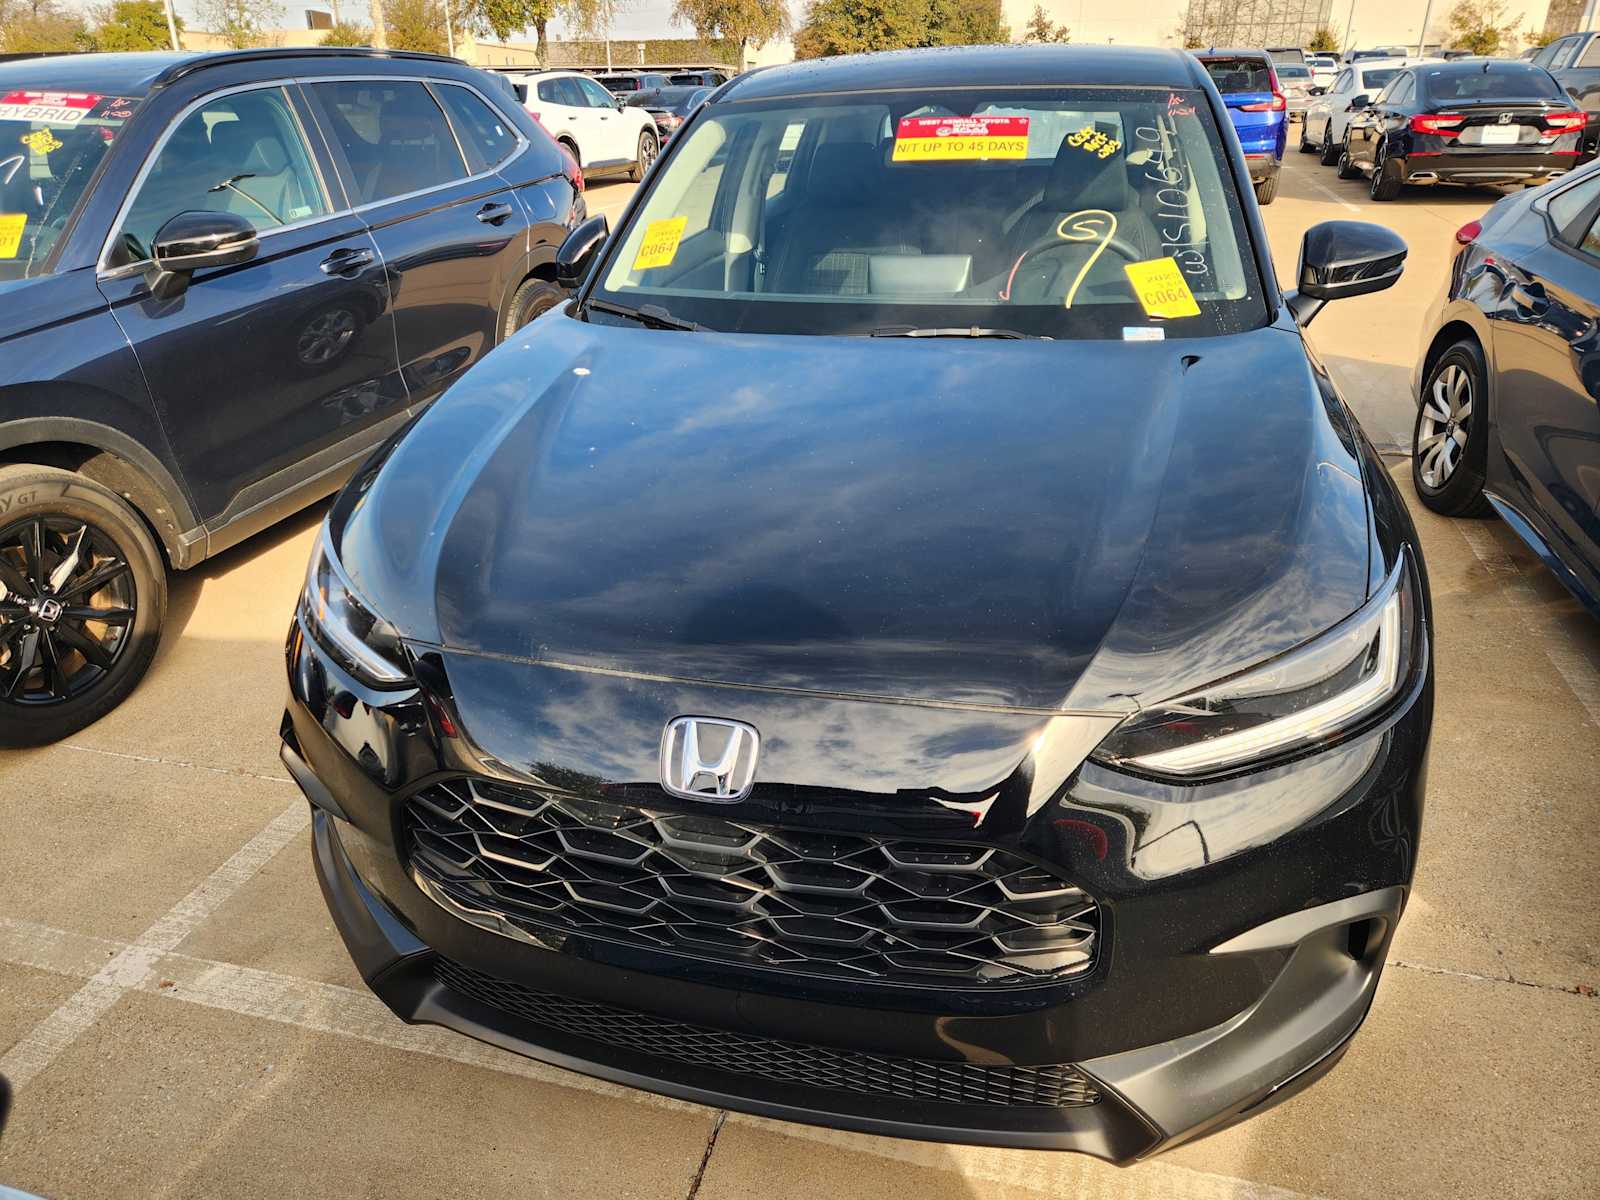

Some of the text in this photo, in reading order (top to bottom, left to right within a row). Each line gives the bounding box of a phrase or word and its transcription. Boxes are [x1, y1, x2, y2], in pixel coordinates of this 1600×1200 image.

[0, 106, 82, 121] HYBRID
[896, 140, 1025, 153] N/T UP TO 45 DAYS
[641, 241, 674, 256] C064
[1144, 288, 1188, 305] C064
[18, 490, 38, 504] GT
